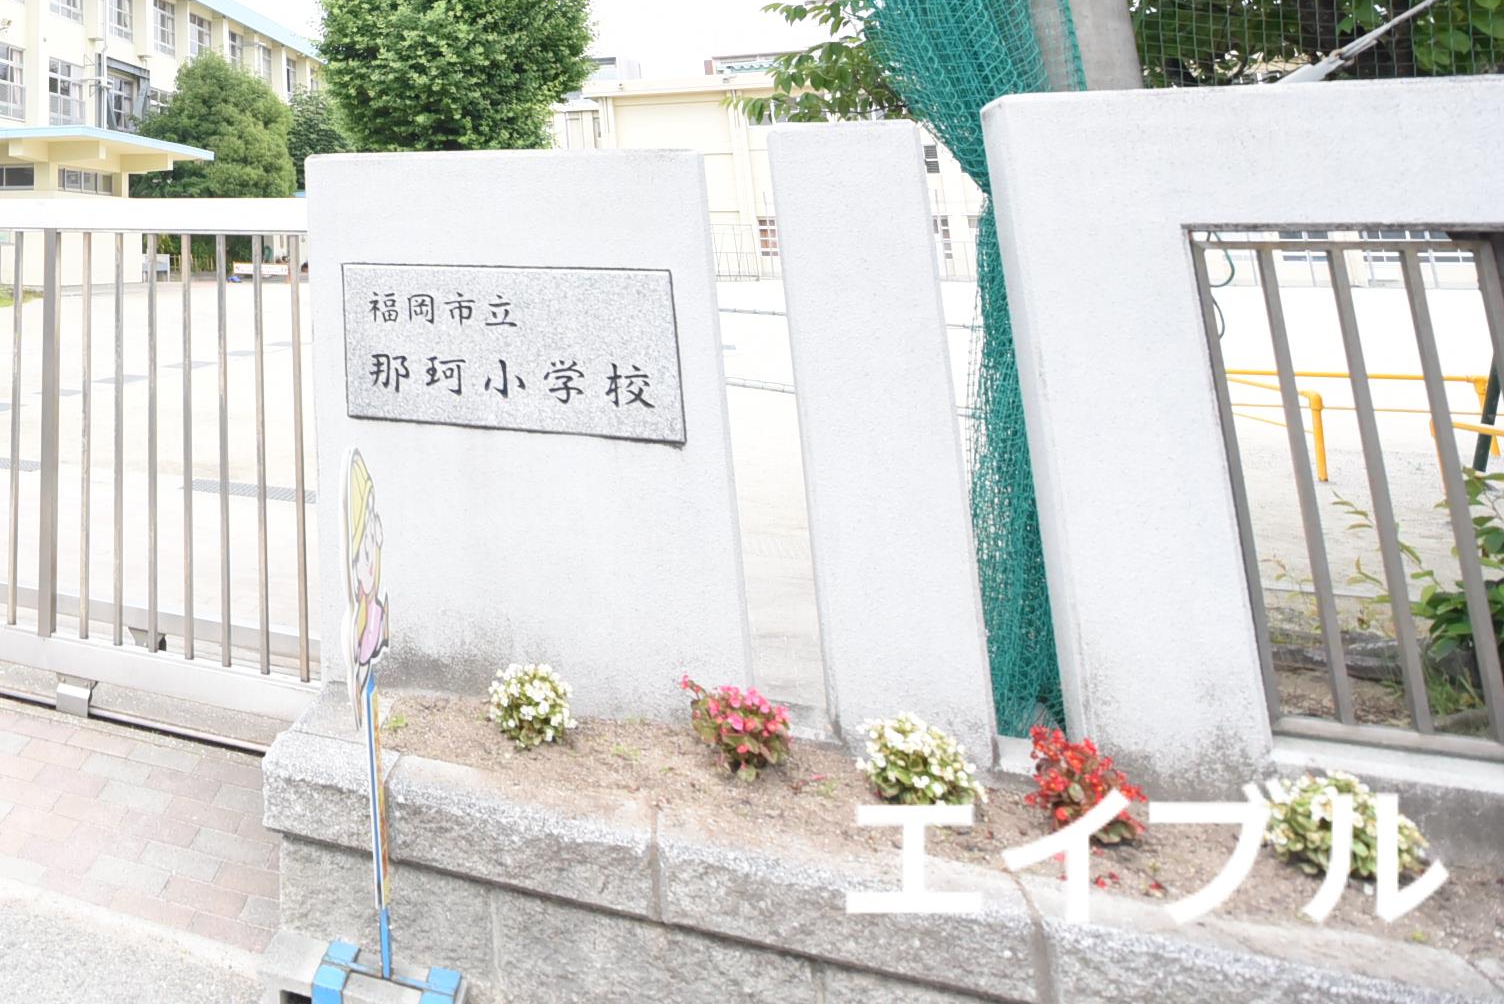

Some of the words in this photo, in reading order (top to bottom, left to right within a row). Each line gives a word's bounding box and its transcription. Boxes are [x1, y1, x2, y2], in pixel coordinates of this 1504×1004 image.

[368, 292, 518, 328] 福岡市立
[368, 353, 656, 409] 那珂小学校
